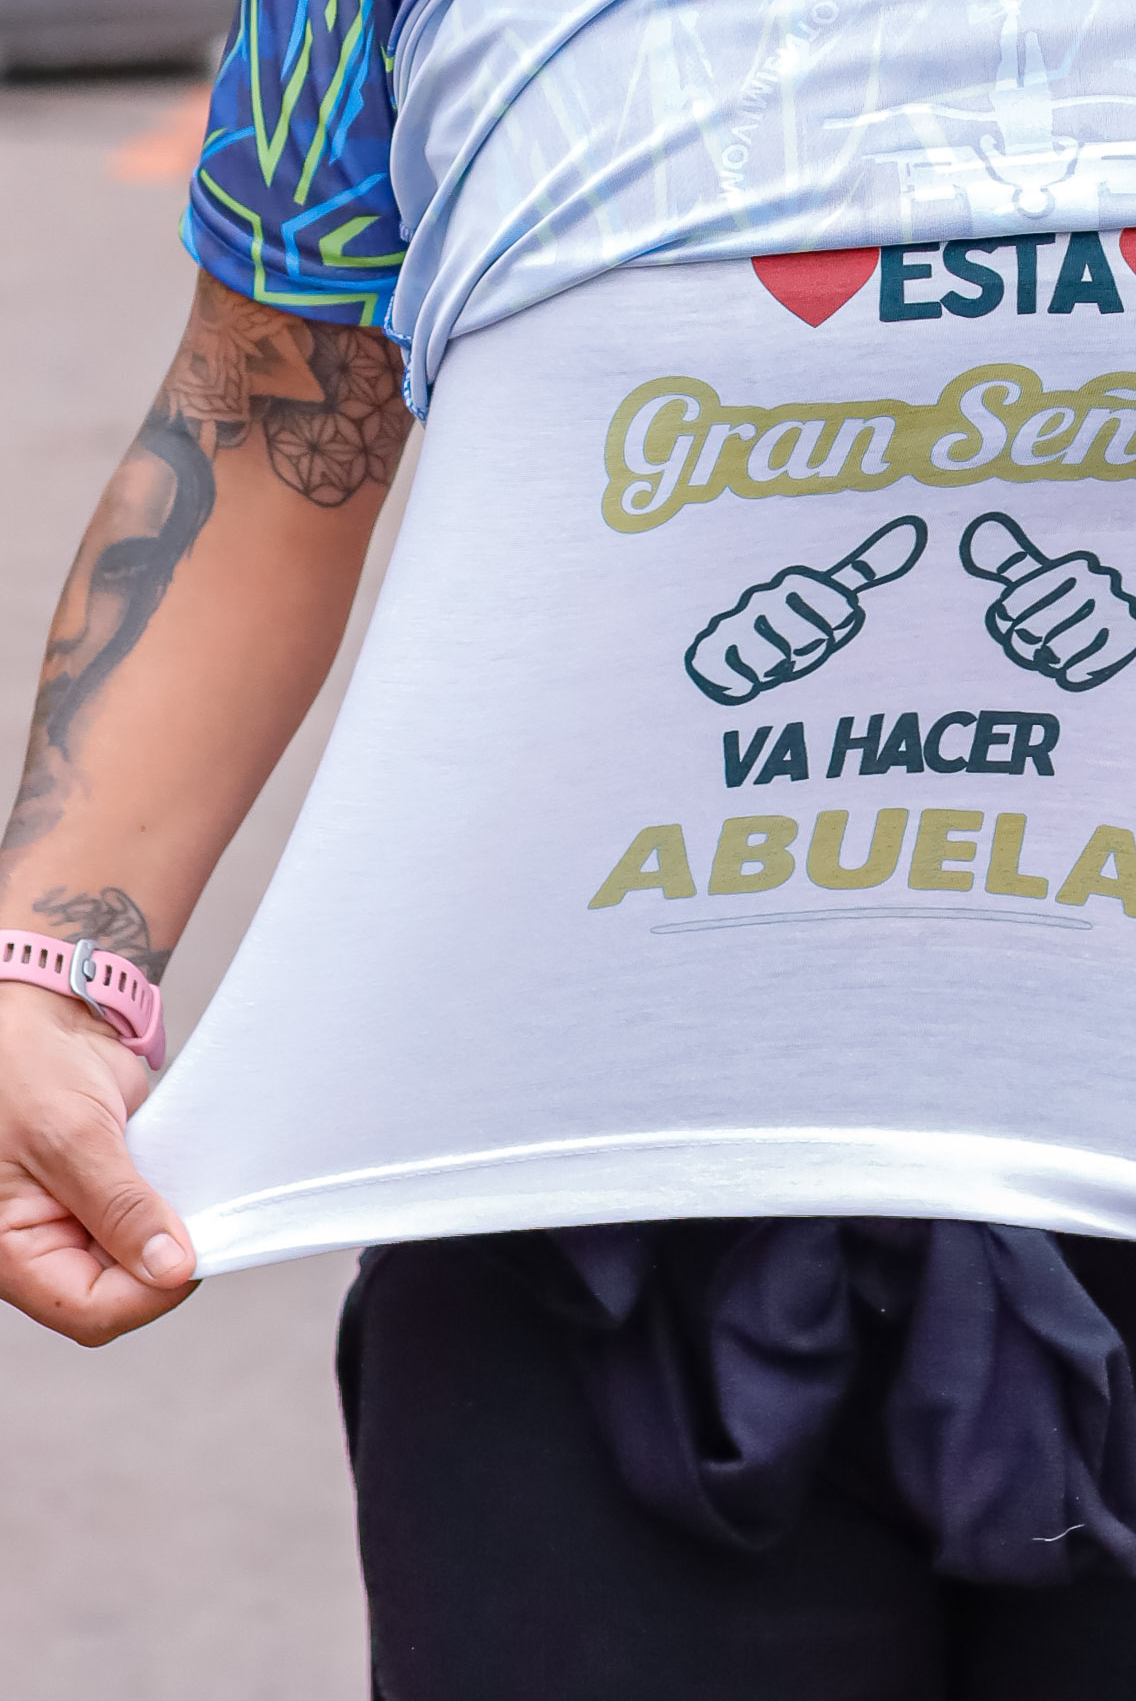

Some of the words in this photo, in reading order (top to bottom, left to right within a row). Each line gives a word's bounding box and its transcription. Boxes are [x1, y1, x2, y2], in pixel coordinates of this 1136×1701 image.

[879, 231, 1125, 322] ESTA
[620, 394, 897, 517] Gran
[722, 721, 810, 788] VA
[826, 711, 1060, 780] HACER
